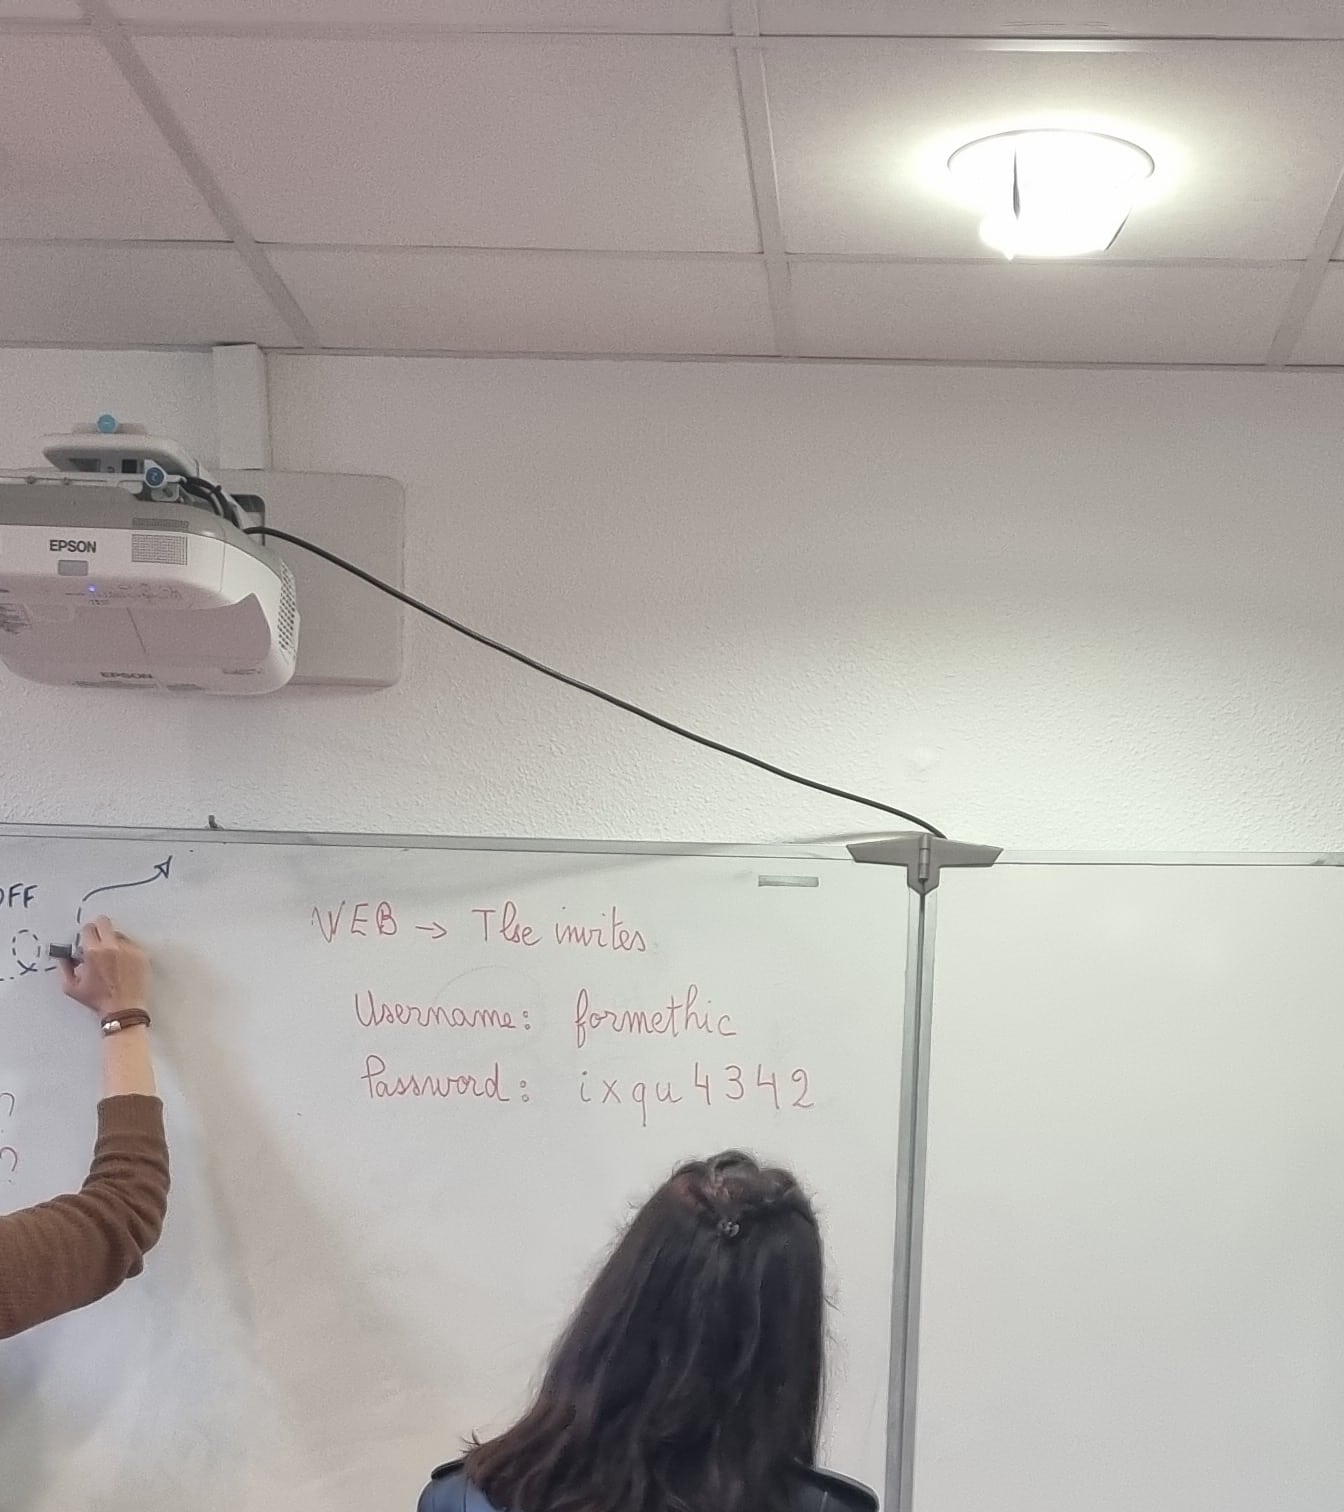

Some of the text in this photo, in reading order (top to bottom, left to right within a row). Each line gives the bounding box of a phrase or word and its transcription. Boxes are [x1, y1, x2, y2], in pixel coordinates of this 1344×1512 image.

[49, 539, 97, 554] EPSON
[311, 900, 400, 944] WEB
[554, 905, 647, 953] invites
[574, 983, 738, 1049] formethic
